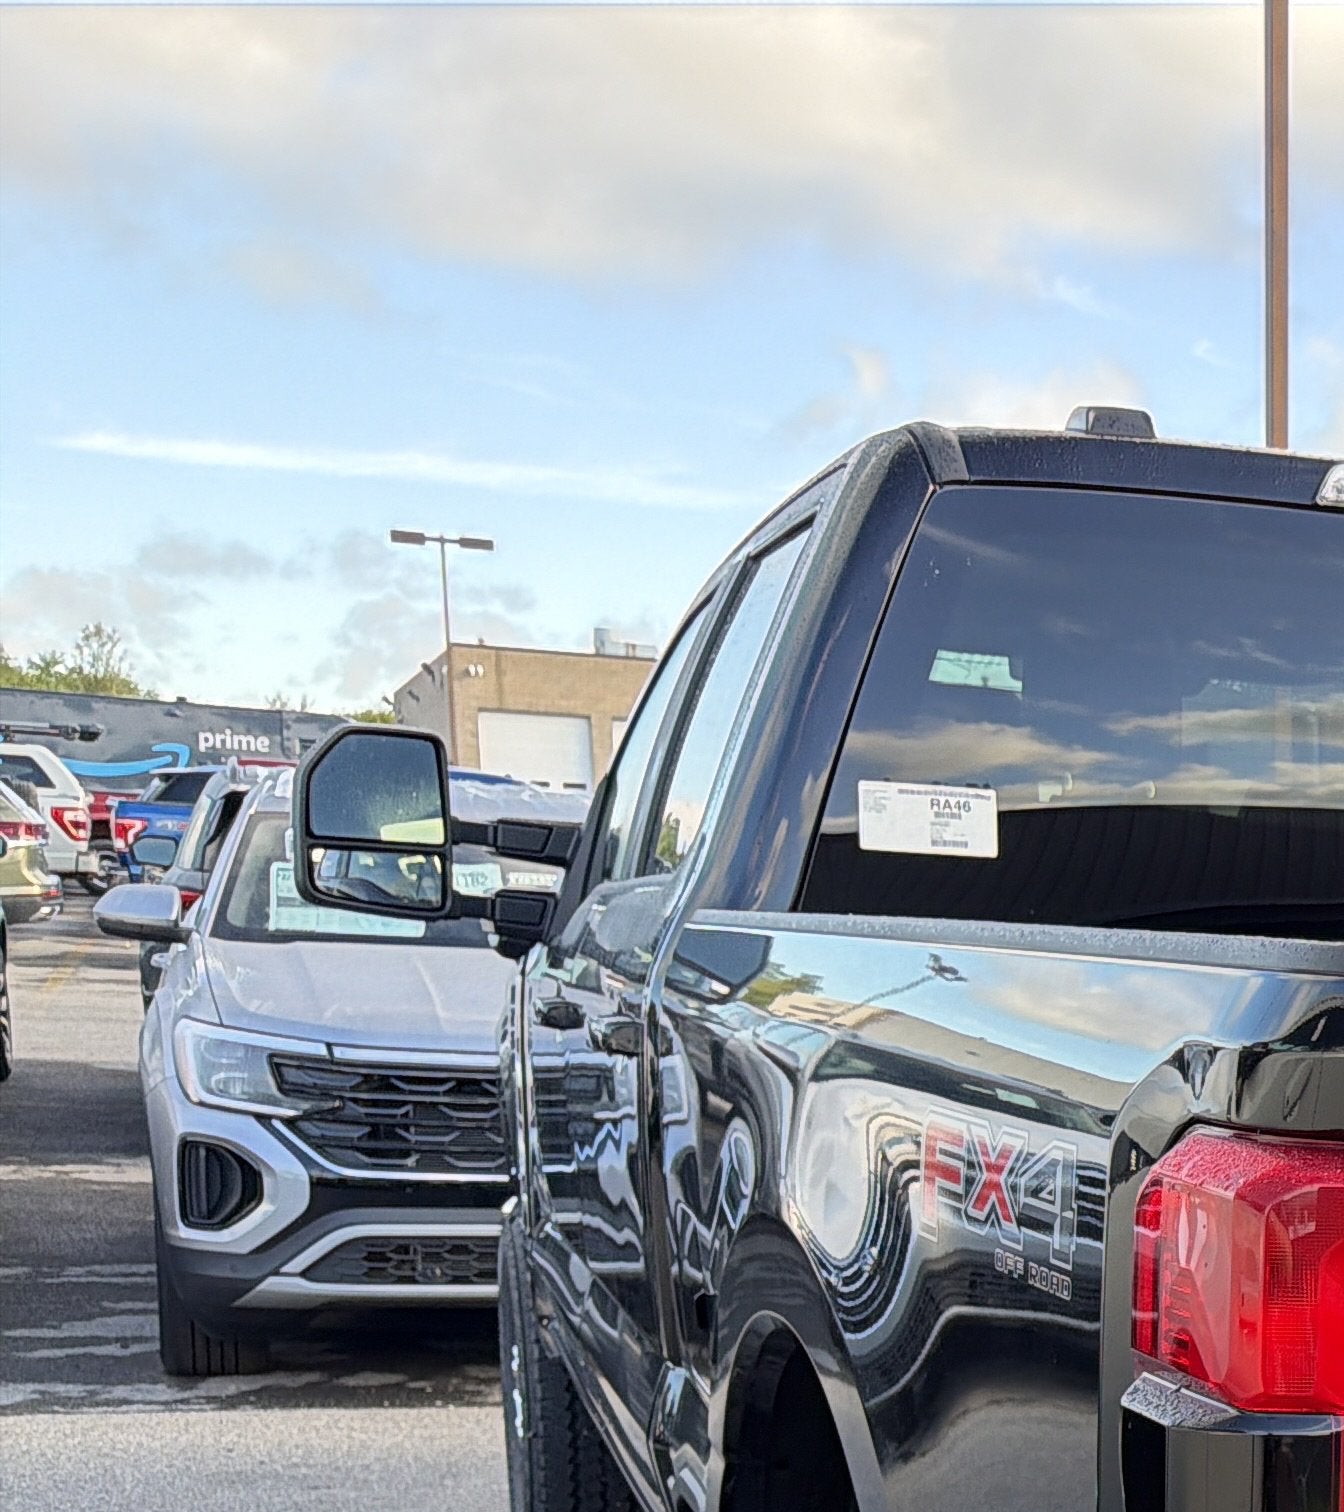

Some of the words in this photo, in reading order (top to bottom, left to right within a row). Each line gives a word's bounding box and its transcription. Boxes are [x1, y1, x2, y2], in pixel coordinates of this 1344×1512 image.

[198, 728, 270, 752] prime
[918, 1105, 1078, 1271] FX4
[995, 1249, 1024, 1278] OFF
[1028, 1261, 1072, 1300] ROAD
